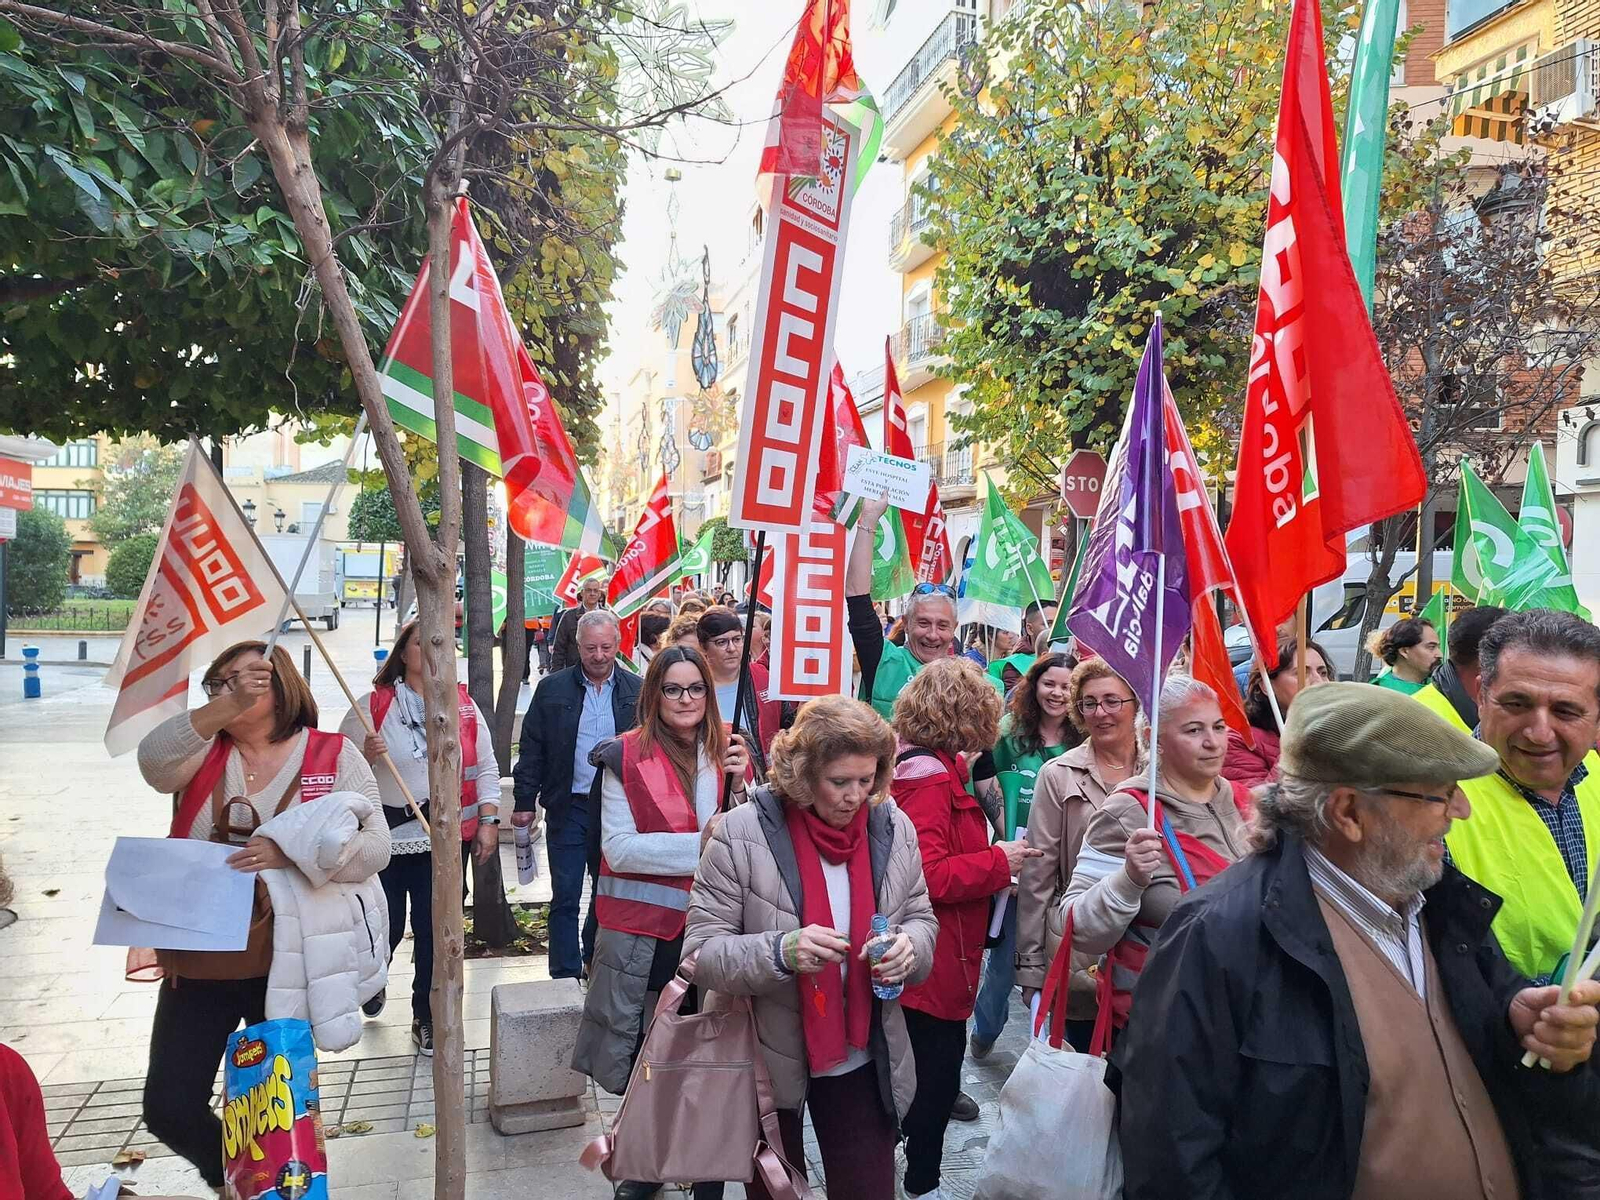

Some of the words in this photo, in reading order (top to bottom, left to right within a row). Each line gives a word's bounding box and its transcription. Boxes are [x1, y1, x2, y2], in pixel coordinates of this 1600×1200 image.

[803, 192, 836, 217] CÓRDOBA
[780, 208, 800, 222] sanidad
[757, 242, 823, 508] CCOO
[877, 455, 917, 471] TECNOS
[865, 468, 879, 476] ESTE
[880, 471, 908, 484] HOSPITAL
[1066, 475, 1100, 492] STO
[861, 479, 875, 487] ESTA
[876, 483, 910, 497] POBLACIÓN
[793, 520, 834, 685] CCOO
[301, 775, 334, 785] CCOO
